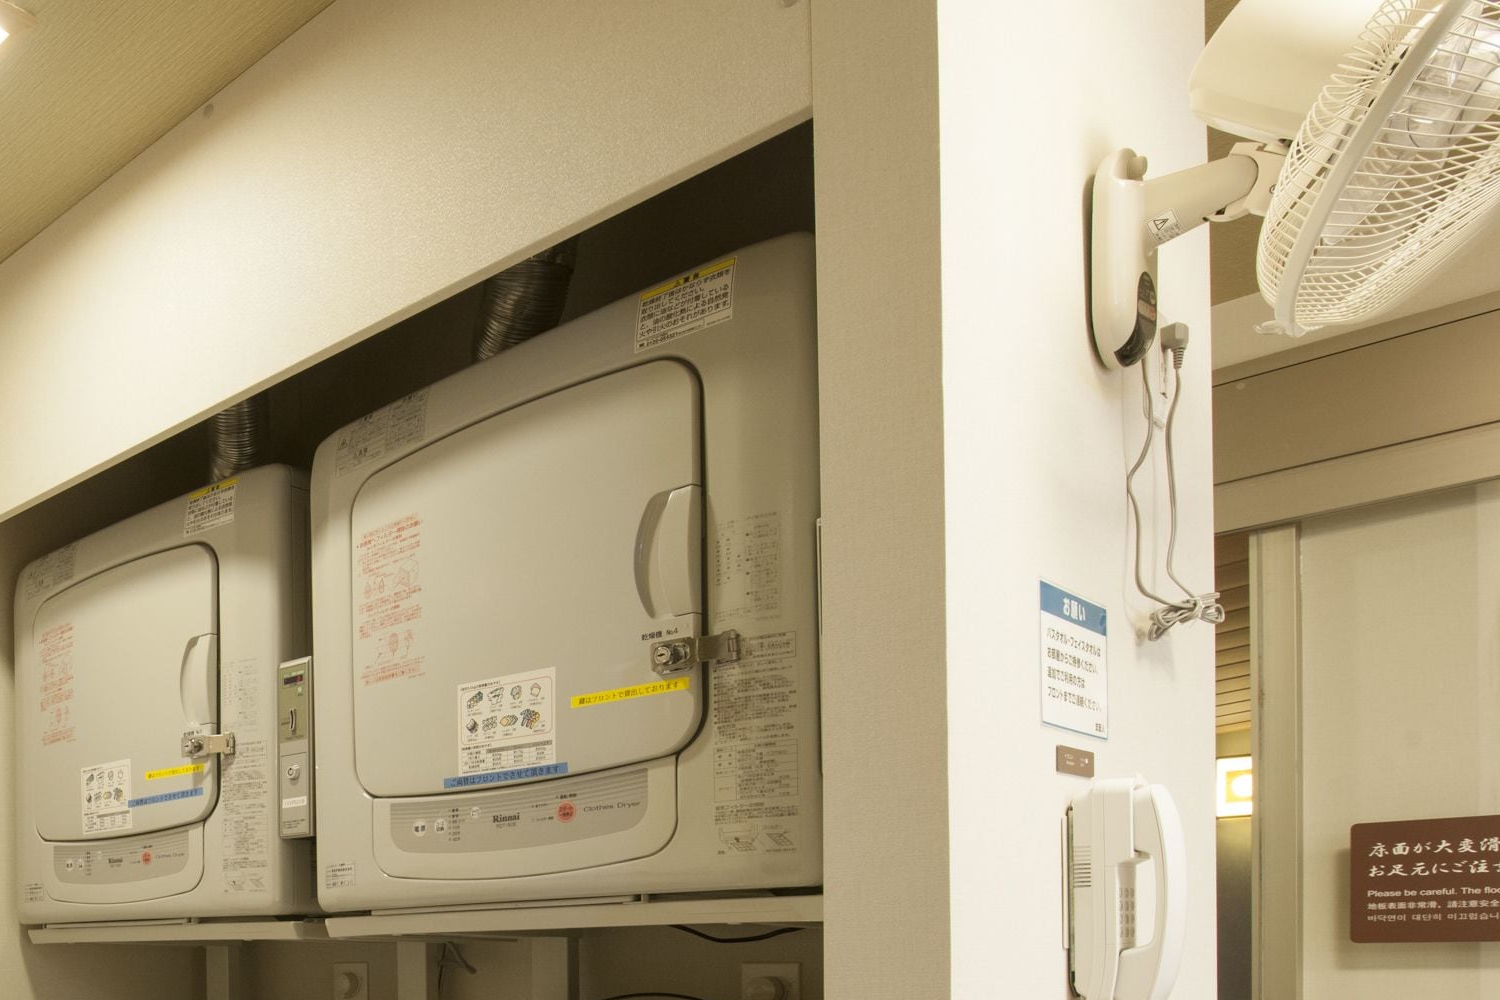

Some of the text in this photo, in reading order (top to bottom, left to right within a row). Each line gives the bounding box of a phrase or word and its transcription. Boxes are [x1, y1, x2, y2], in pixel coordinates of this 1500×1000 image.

[1063, 597, 1086, 622] お願い
[492, 811, 521, 823] Rinnai
[1367, 890, 1402, 898] Please
[1404, 888, 1418, 897] be
[1420, 887, 1458, 897] careful.
[1461, 886, 1482, 895] The
